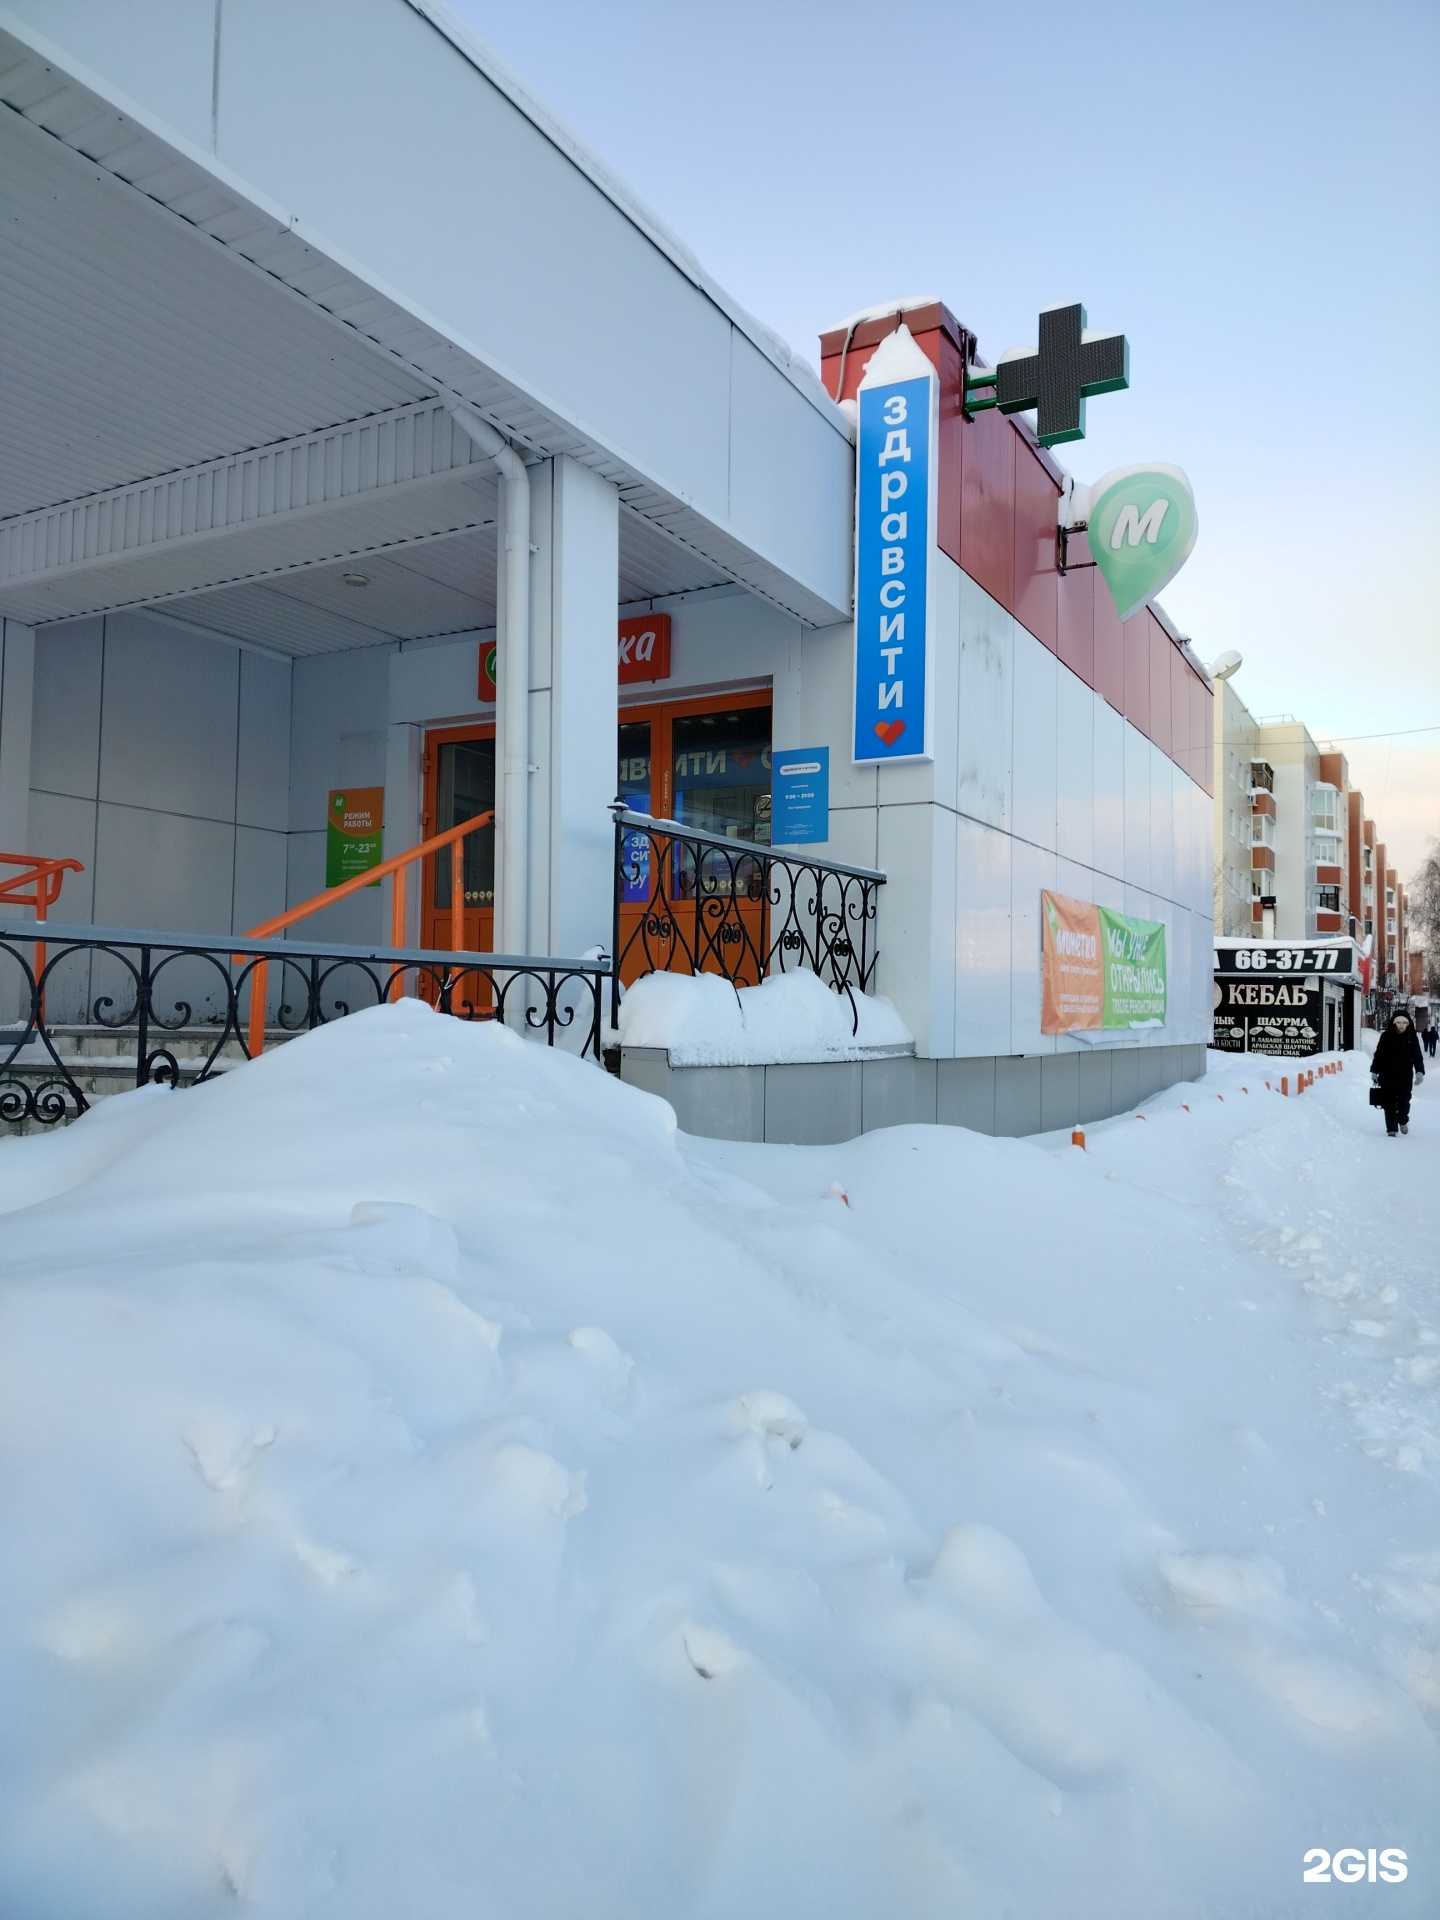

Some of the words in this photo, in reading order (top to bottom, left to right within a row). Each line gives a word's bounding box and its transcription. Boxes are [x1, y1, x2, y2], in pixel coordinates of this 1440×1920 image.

[343, 819, 372, 829] РАБОТЫ
[1235, 949, 1339, 970] 66-37-77
[1228, 984, 1308, 1006] КЕБАБ
[1257, 1017, 1309, 1027] ШАУРМА
